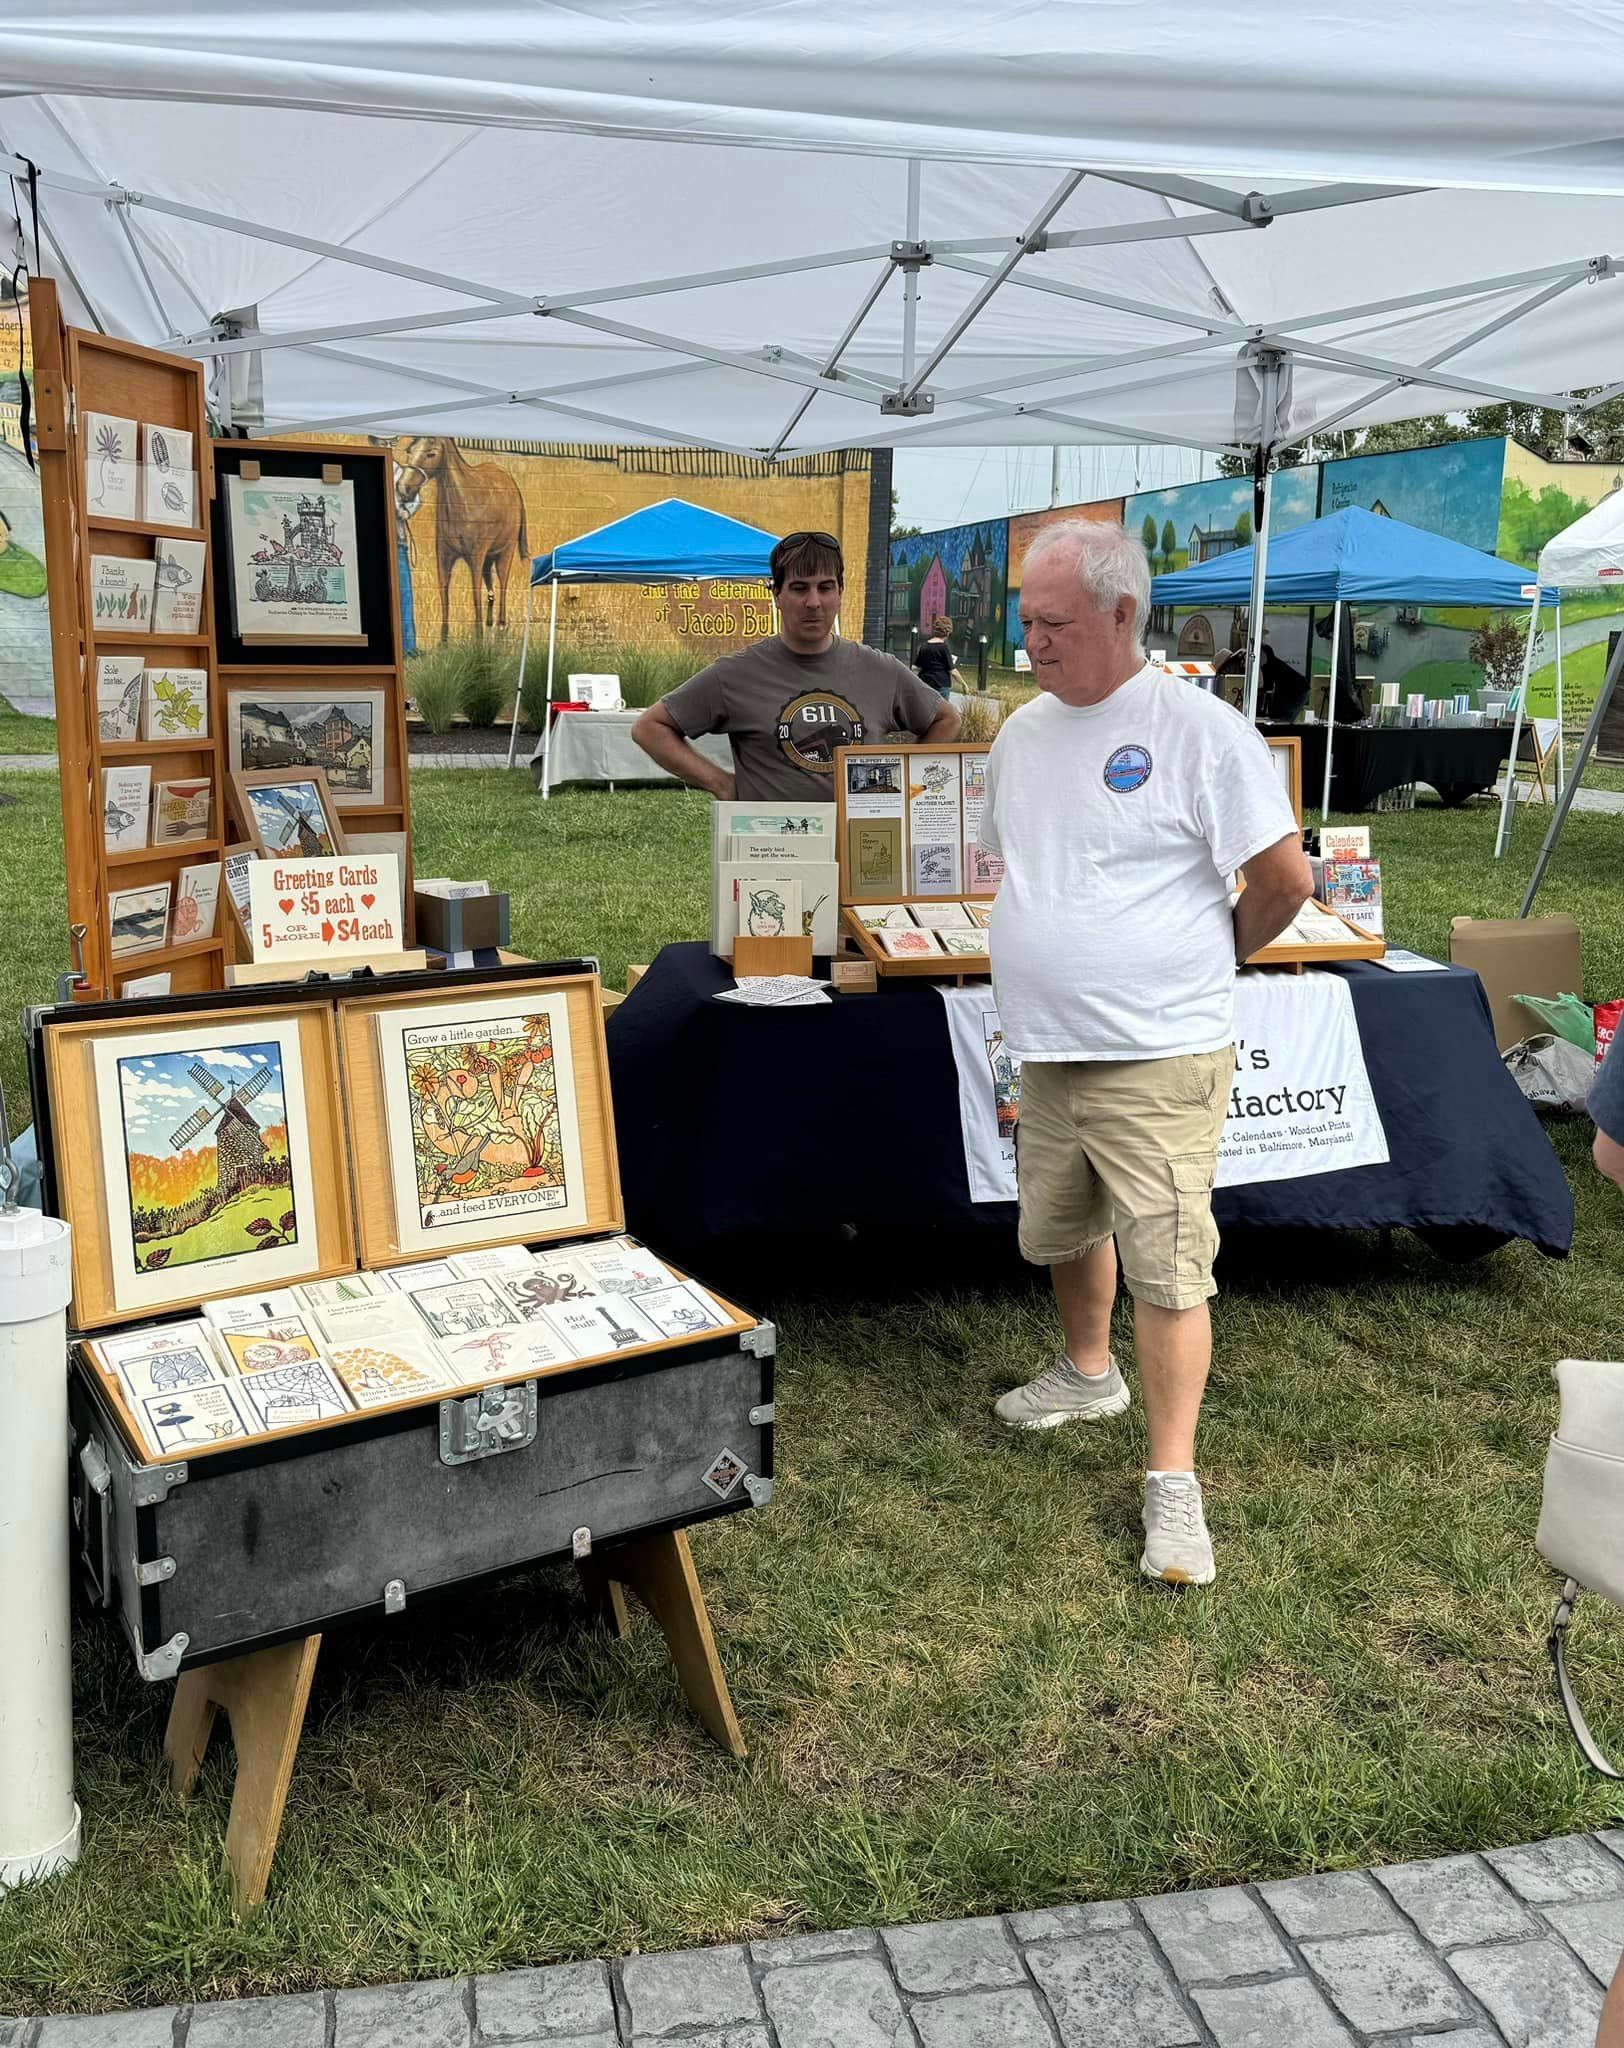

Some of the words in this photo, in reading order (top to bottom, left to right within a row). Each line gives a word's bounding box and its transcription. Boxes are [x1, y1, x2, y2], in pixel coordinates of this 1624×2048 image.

[101, 564, 126, 576] Thanks
[642, 584, 667, 598] and
[673, 583, 699, 598] the
[655, 604, 670, 623] of
[679, 604, 736, 635] Jacob
[104, 664, 119, 675] Sole
[801, 705, 838, 723] 611
[779, 724, 789, 739] 20
[853, 724, 862, 738] 15
[1326, 834, 1364, 848] Calendars
[273, 869, 334, 891] Greeting
[339, 864, 378, 886] Cards
[301, 891, 320, 915] $5
[324, 892, 355, 914] each
[1356, 912, 1375, 920] SAFE!
[262, 923, 273, 948] 5
[286, 924, 308, 932] OR
[362, 918, 393, 940] each
[274, 932, 320, 942] MORE
[407, 1033, 439, 1045] Grow
[449, 1029, 474, 1041] little
[1226, 1085, 1347, 1120] factory
[1232, 1129, 1283, 1143] Calendars
[1288, 1123, 1327, 1136] Woodcut
[1246, 1146, 1256, 1156] in
[1260, 1140, 1306, 1154] Baltimore,
[1308, 1131, 1354, 1148] Maryland!
[463, 1202, 486, 1214] feed
[564, 1312, 587, 1324] Hot
